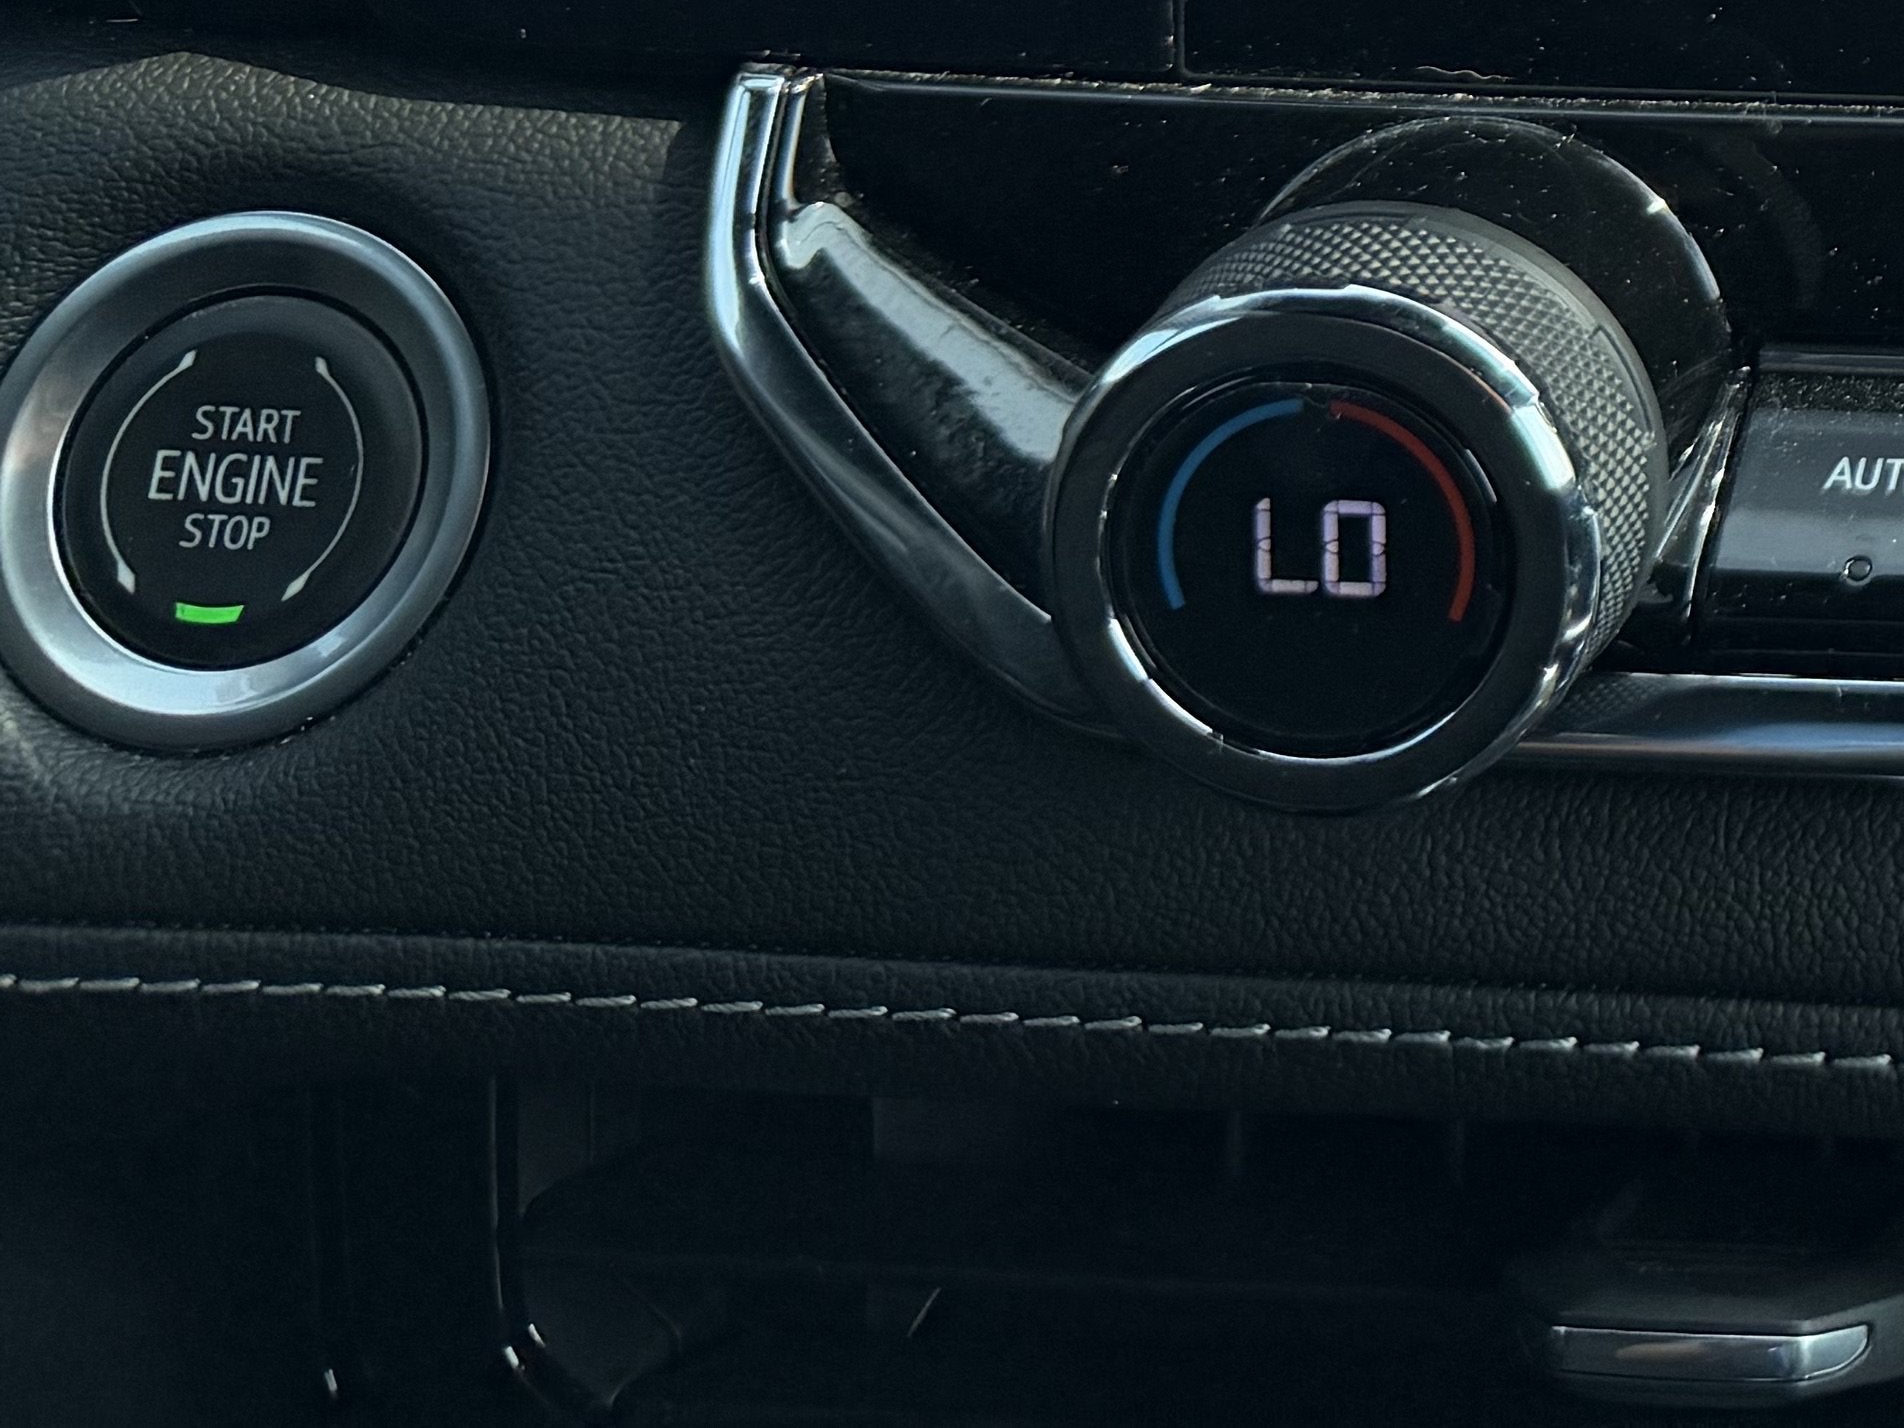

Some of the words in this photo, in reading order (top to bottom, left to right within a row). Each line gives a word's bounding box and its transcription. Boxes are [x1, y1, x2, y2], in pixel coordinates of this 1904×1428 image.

[192, 405, 301, 444] START
[148, 450, 323, 507] ENGINE
[179, 514, 271, 550] STOP
[1255, 497, 1387, 597] LO
